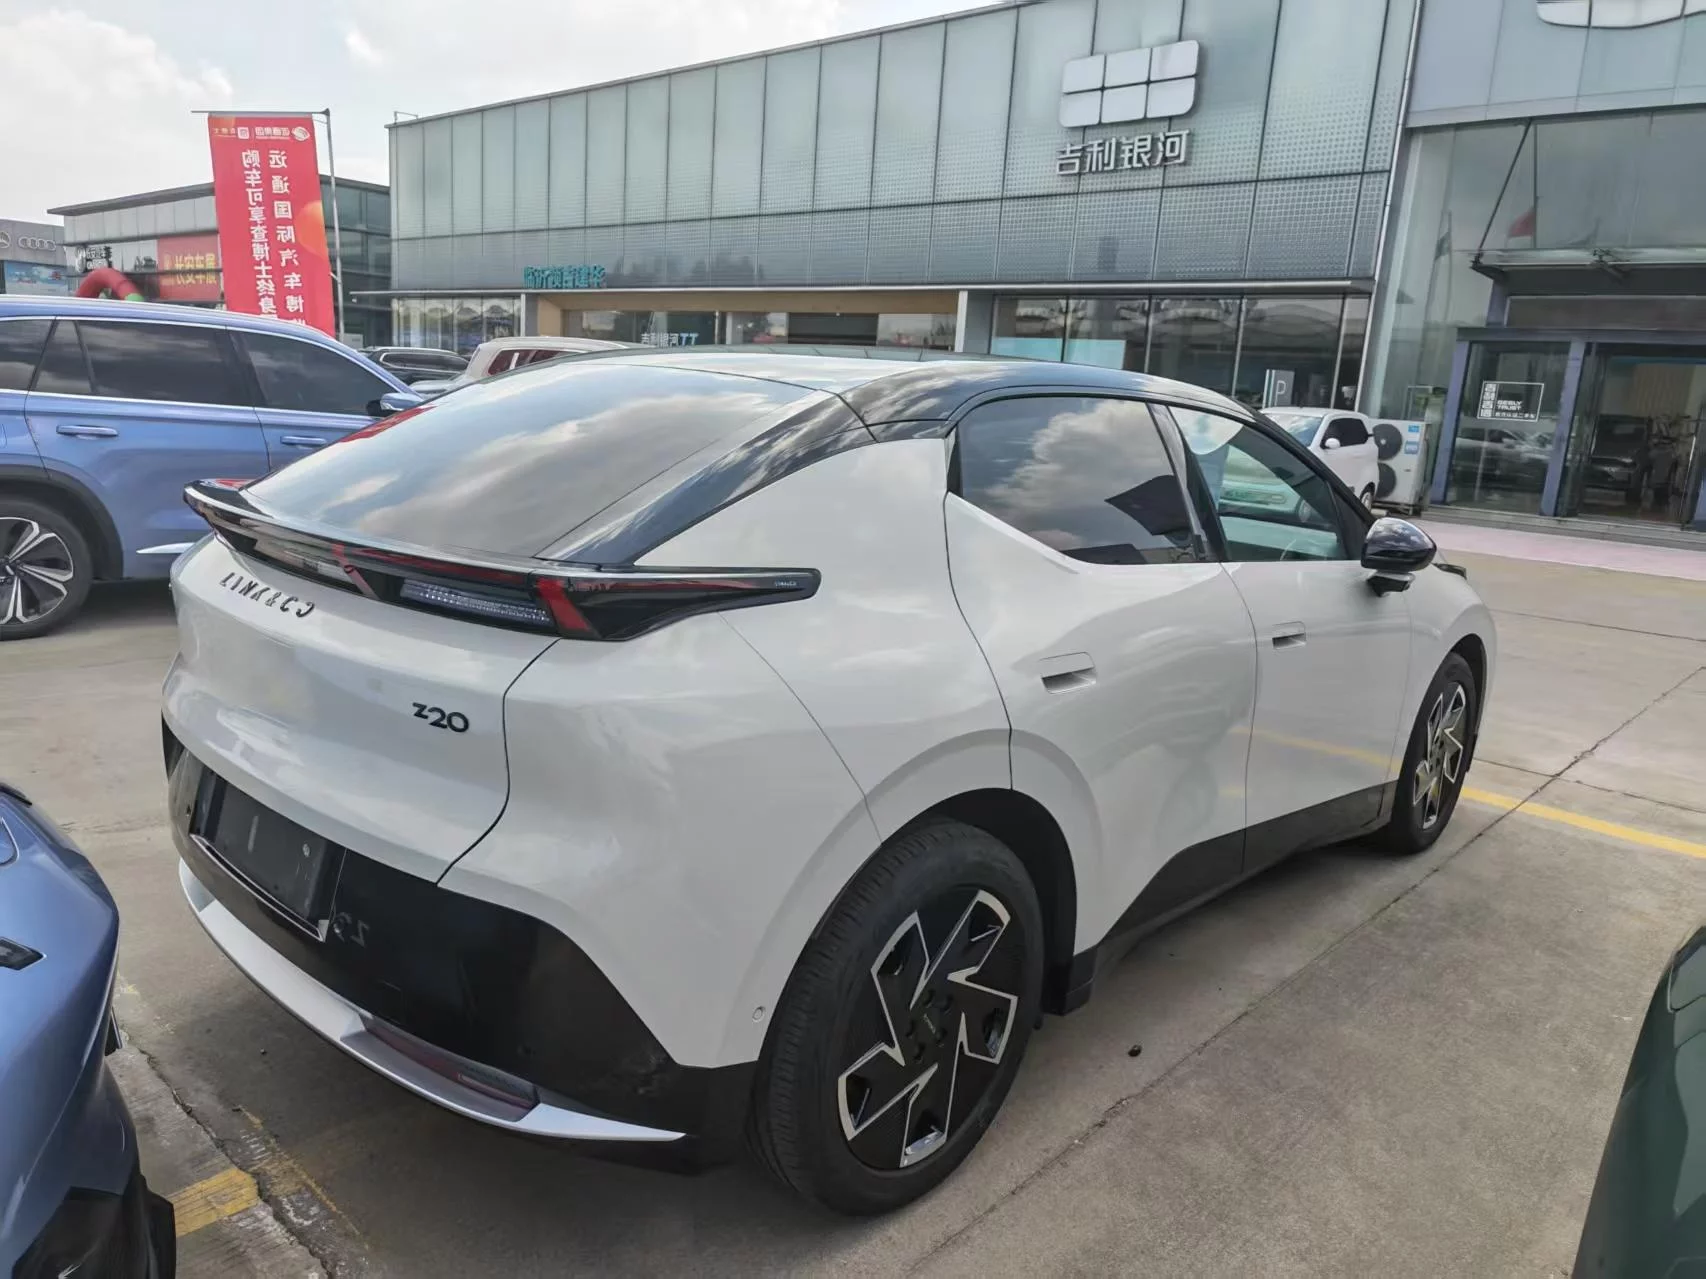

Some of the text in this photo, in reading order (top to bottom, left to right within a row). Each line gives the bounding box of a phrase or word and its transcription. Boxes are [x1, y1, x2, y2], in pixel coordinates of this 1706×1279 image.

[1056, 129, 1190, 176] 吉利银河
[412, 702, 470, 733] Z20
